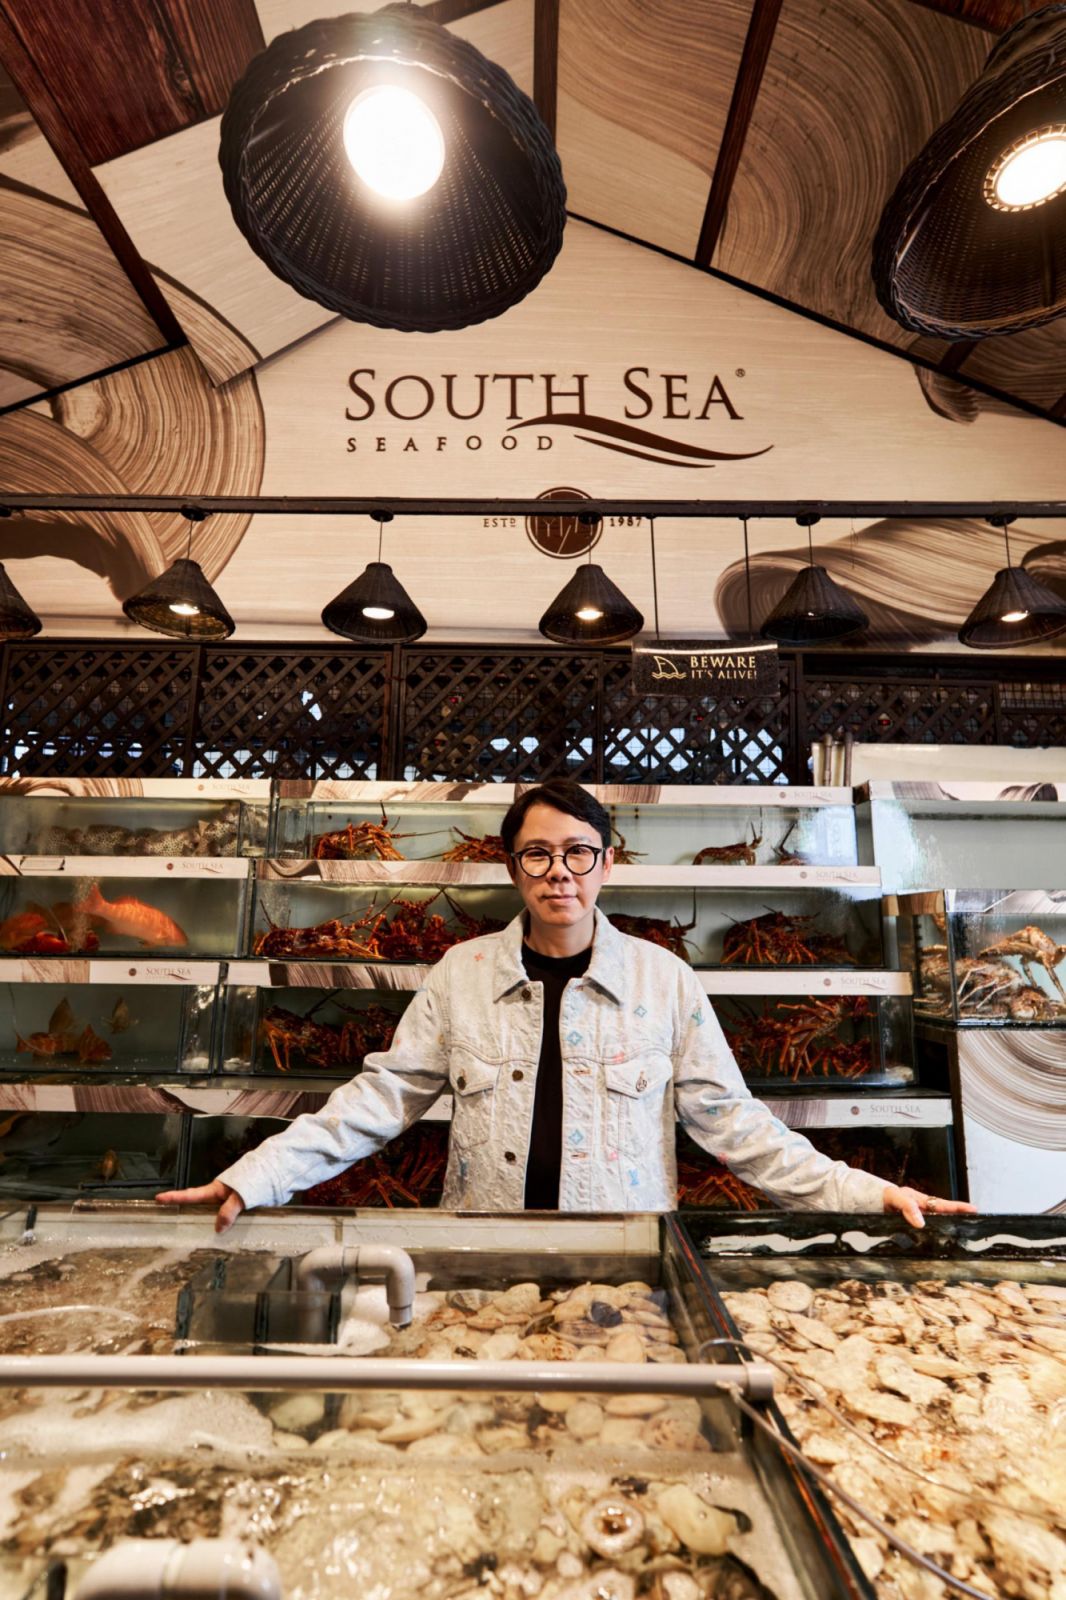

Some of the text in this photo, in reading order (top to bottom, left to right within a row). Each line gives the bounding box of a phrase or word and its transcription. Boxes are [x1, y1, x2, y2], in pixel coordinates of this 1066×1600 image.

[345, 368, 589, 421] SOUTH
[347, 434, 553, 452] SEAFOOD
[610, 517, 642, 527] 1987
[690, 655, 756, 668] BEWARE
[691, 669, 757, 680] IT'S ALIVE!
[146, 967, 173, 975] SOUTH
[870, 1104, 901, 1113] SOUTH
